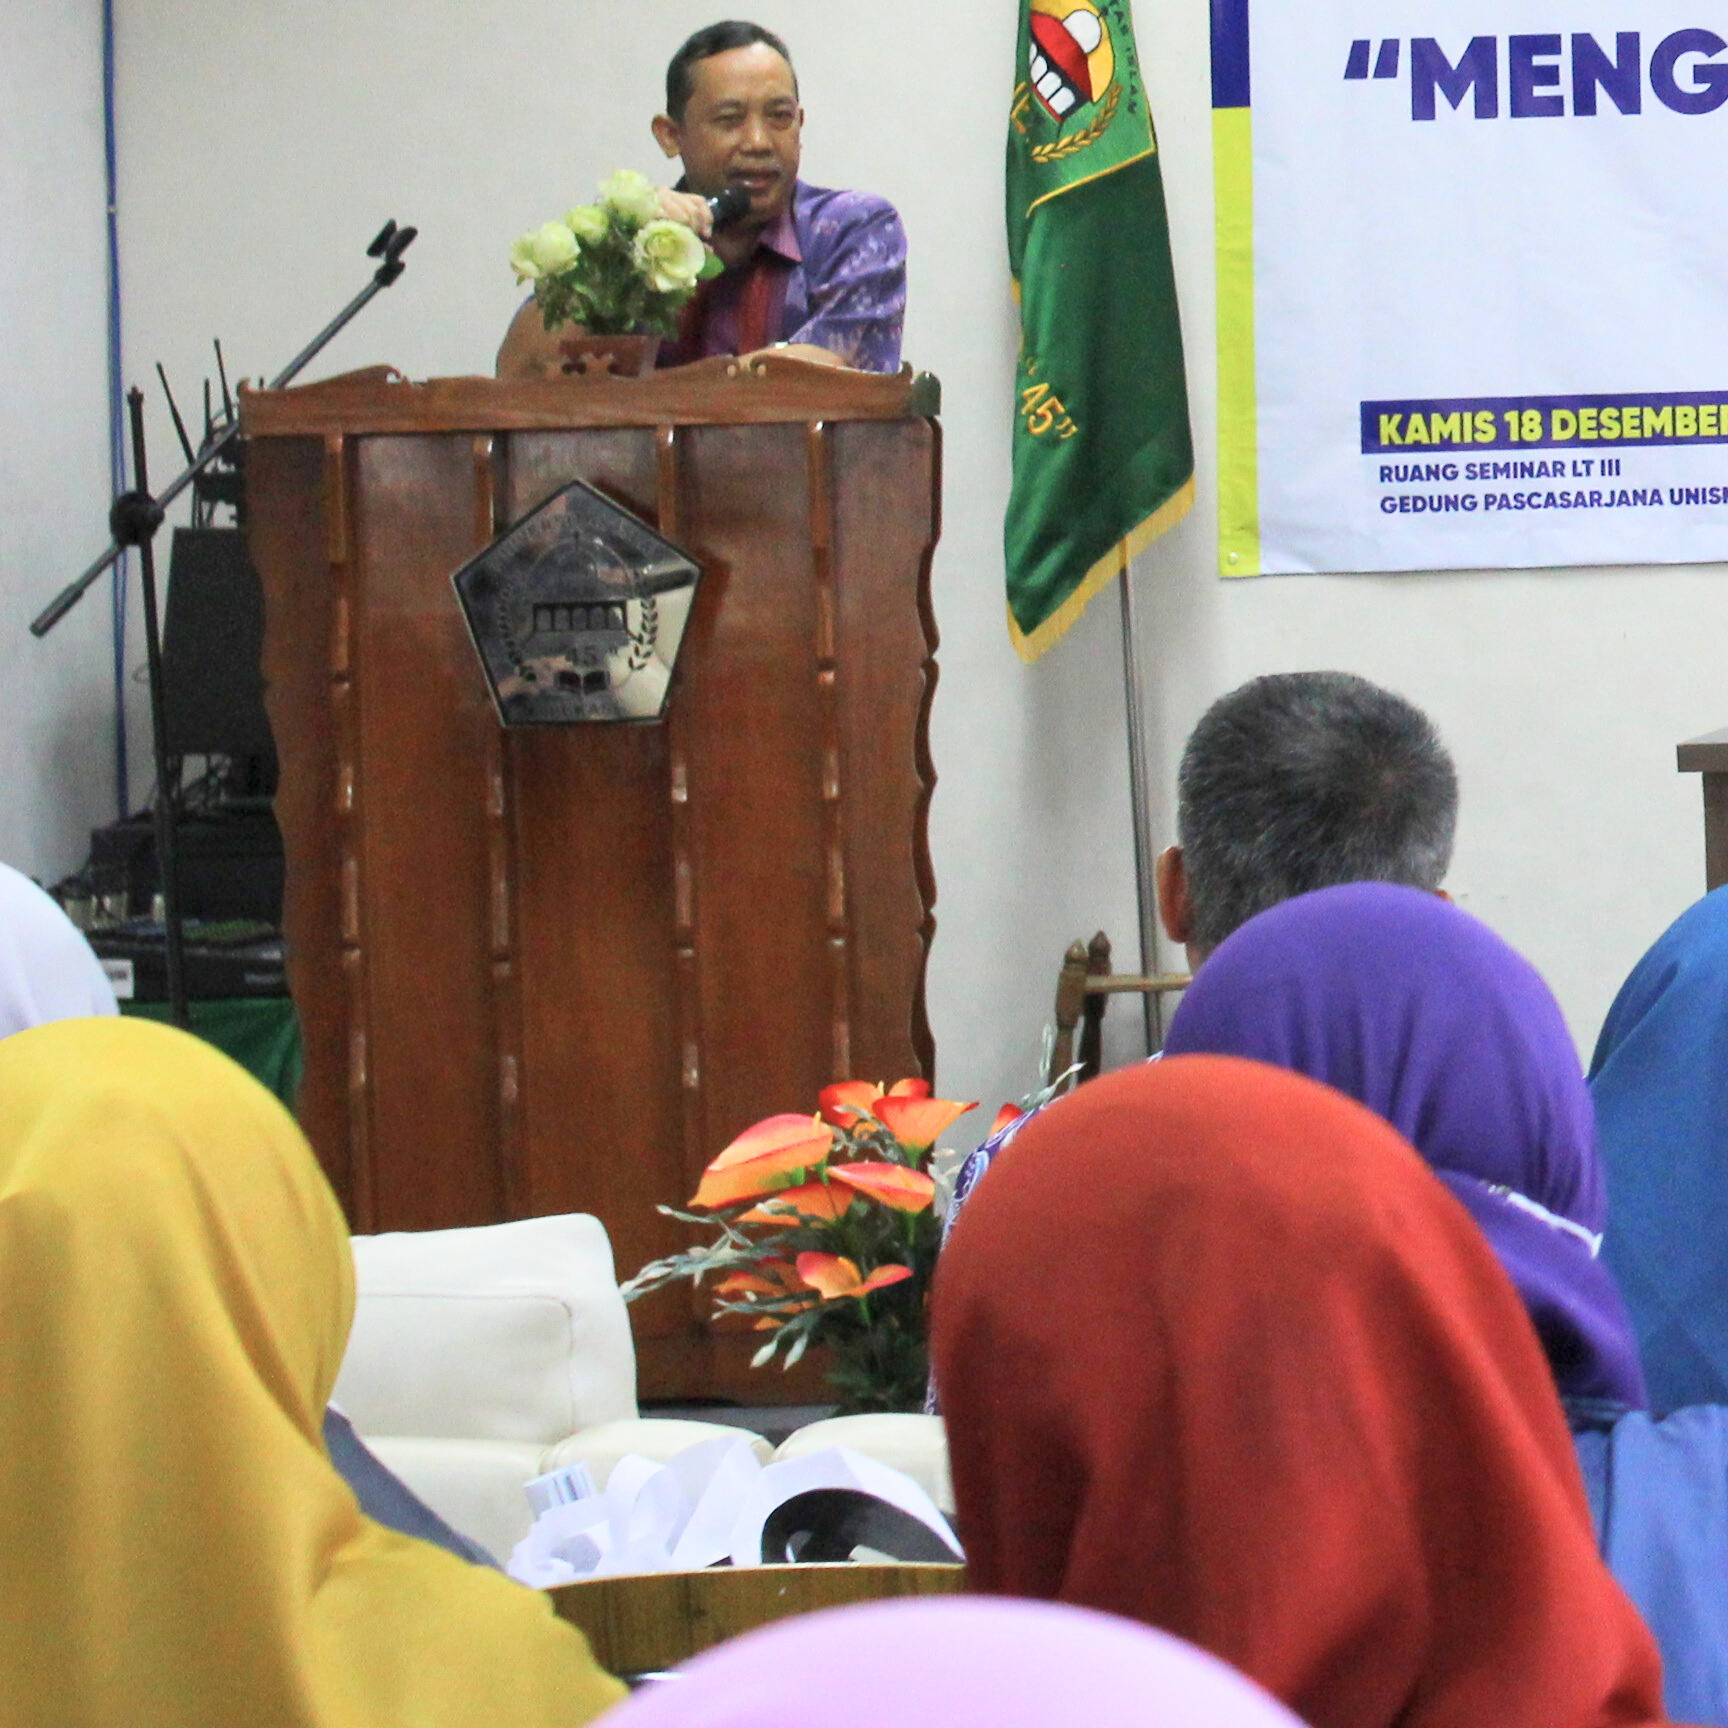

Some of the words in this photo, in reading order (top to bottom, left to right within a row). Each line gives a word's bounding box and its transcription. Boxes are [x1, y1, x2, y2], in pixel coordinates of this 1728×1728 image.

[1379, 411, 1496, 446] KAMIS
[1505, 409, 1543, 442] 18
[1379, 463, 1459, 483] RUANG
[1465, 460, 1565, 481] SEMINAR
[1572, 459, 1596, 477] LT
[1600, 458, 1620, 477] III
[1381, 494, 1477, 515] GEDUNG
[1484, 488, 1663, 512] PASCASARJANA
